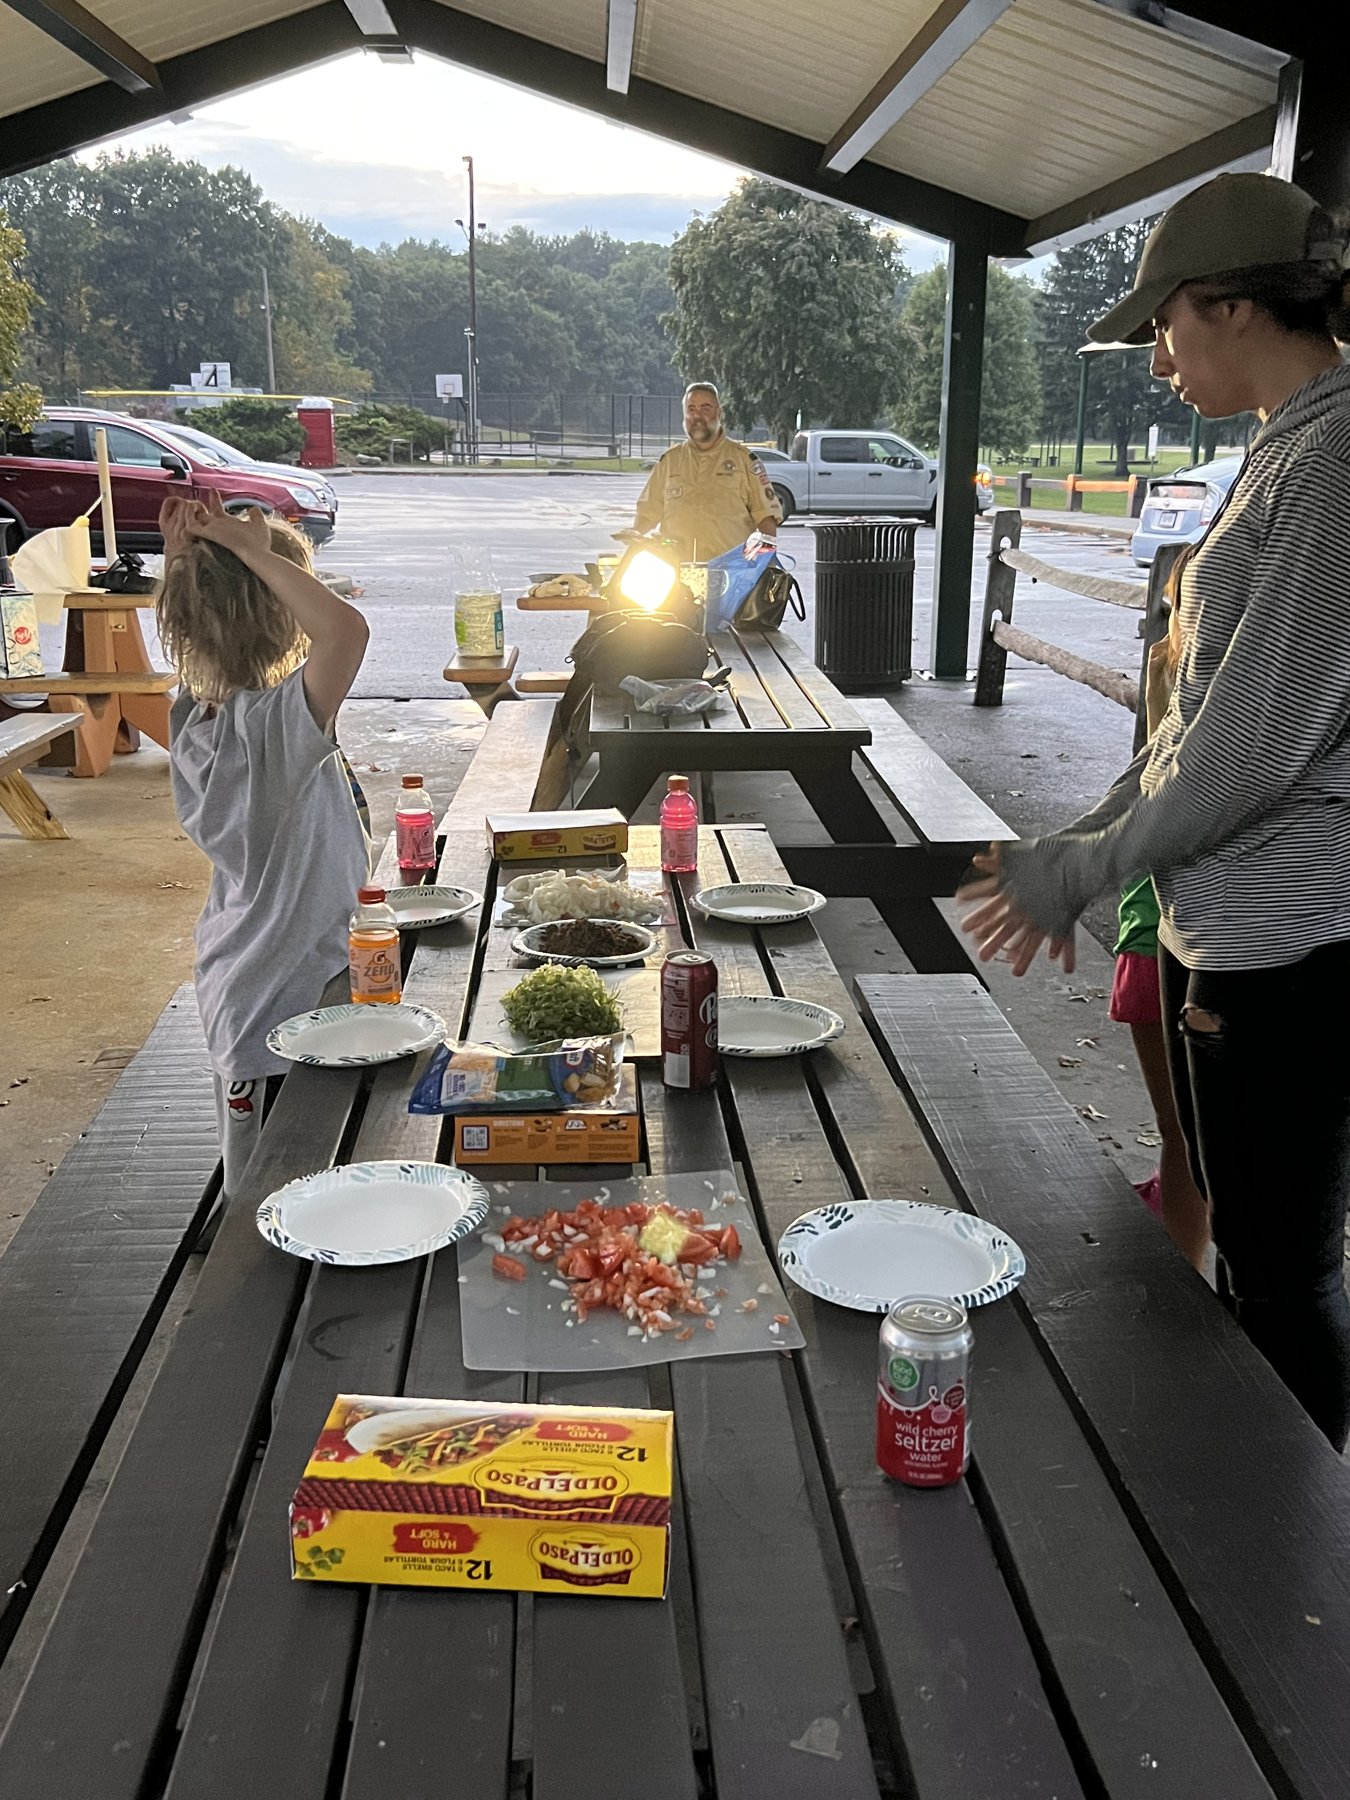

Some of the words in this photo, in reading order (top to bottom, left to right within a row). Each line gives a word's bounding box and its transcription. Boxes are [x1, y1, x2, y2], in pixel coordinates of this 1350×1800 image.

[363, 963, 395, 977] ZERO
[556, 1424, 589, 1432] SOFT
[895, 1421, 920, 1436] wild
[922, 1424, 958, 1437] cherry
[568, 1431, 608, 1440] HARD
[522, 1440, 571, 1448] TORTILLAS
[575, 1442, 606, 1450] FLOUR
[895, 1434, 959, 1452] seltzer
[616, 1446, 648, 1462] 12
[909, 1452, 942, 1462] water
[574, 1475, 618, 1491] OLD
[409, 1528, 440, 1539] SOFT
[422, 1539, 457, 1550] HARD
[430, 1557, 456, 1565] FLOUR
[602, 1548, 633, 1565] OLD
[465, 1559, 493, 1580] 12
